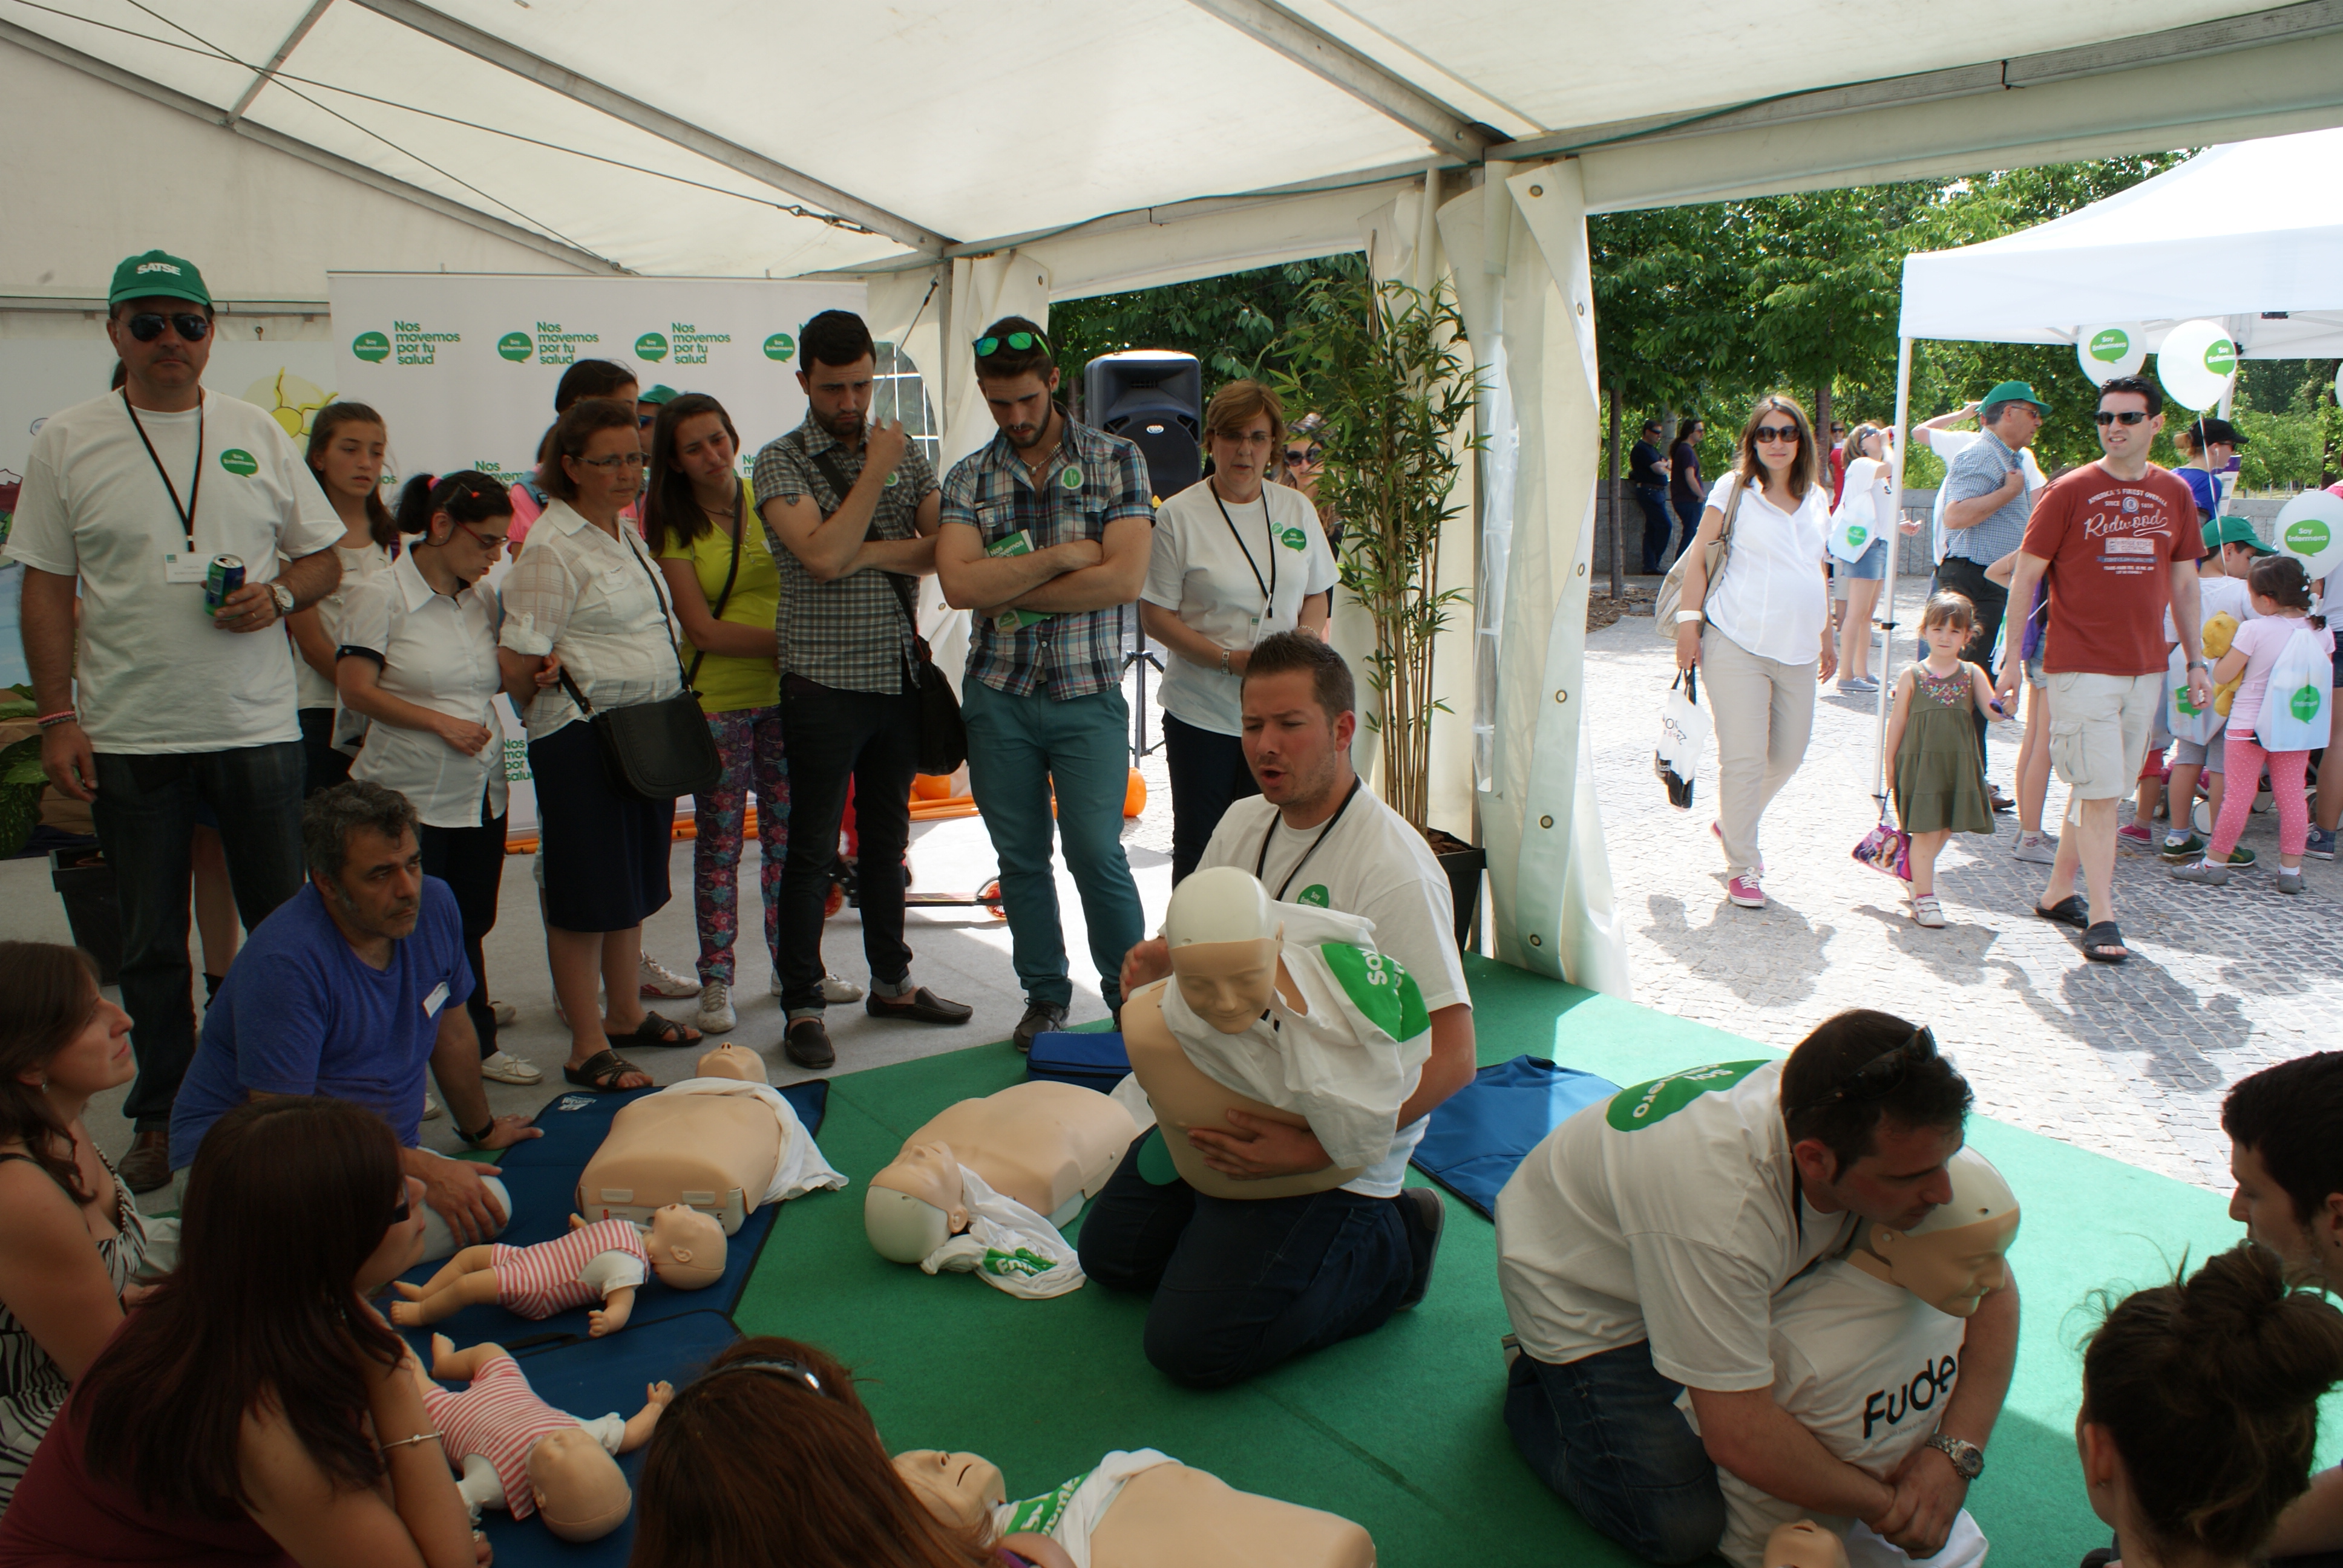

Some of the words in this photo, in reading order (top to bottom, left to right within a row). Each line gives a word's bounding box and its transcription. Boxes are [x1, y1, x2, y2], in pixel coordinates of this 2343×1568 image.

[136, 262, 182, 276] SATSE
[394, 320, 421, 332] Nos
[536, 321, 562, 332] Nos
[672, 322, 695, 333] Nos
[395, 333, 460, 342] movemos
[538, 334, 599, 343] movemos
[673, 334, 731, 343] movemos
[397, 344, 419, 354] por
[423, 342, 435, 353] tu
[539, 344, 560, 354] por
[563, 343, 575, 353] tu
[673, 344, 694, 354] por
[697, 343, 708, 353] tu
[398, 354, 434, 364] salud
[540, 354, 574, 364] salud
[675, 354, 707, 364] salud
[474, 460, 500, 471] Nos
[2122, 488, 2144, 497] FINEST
[2145, 492, 2168, 507] OVERALL
[2084, 509, 2171, 540] Redwood
[1863, 1354, 1956, 1439] Fude
